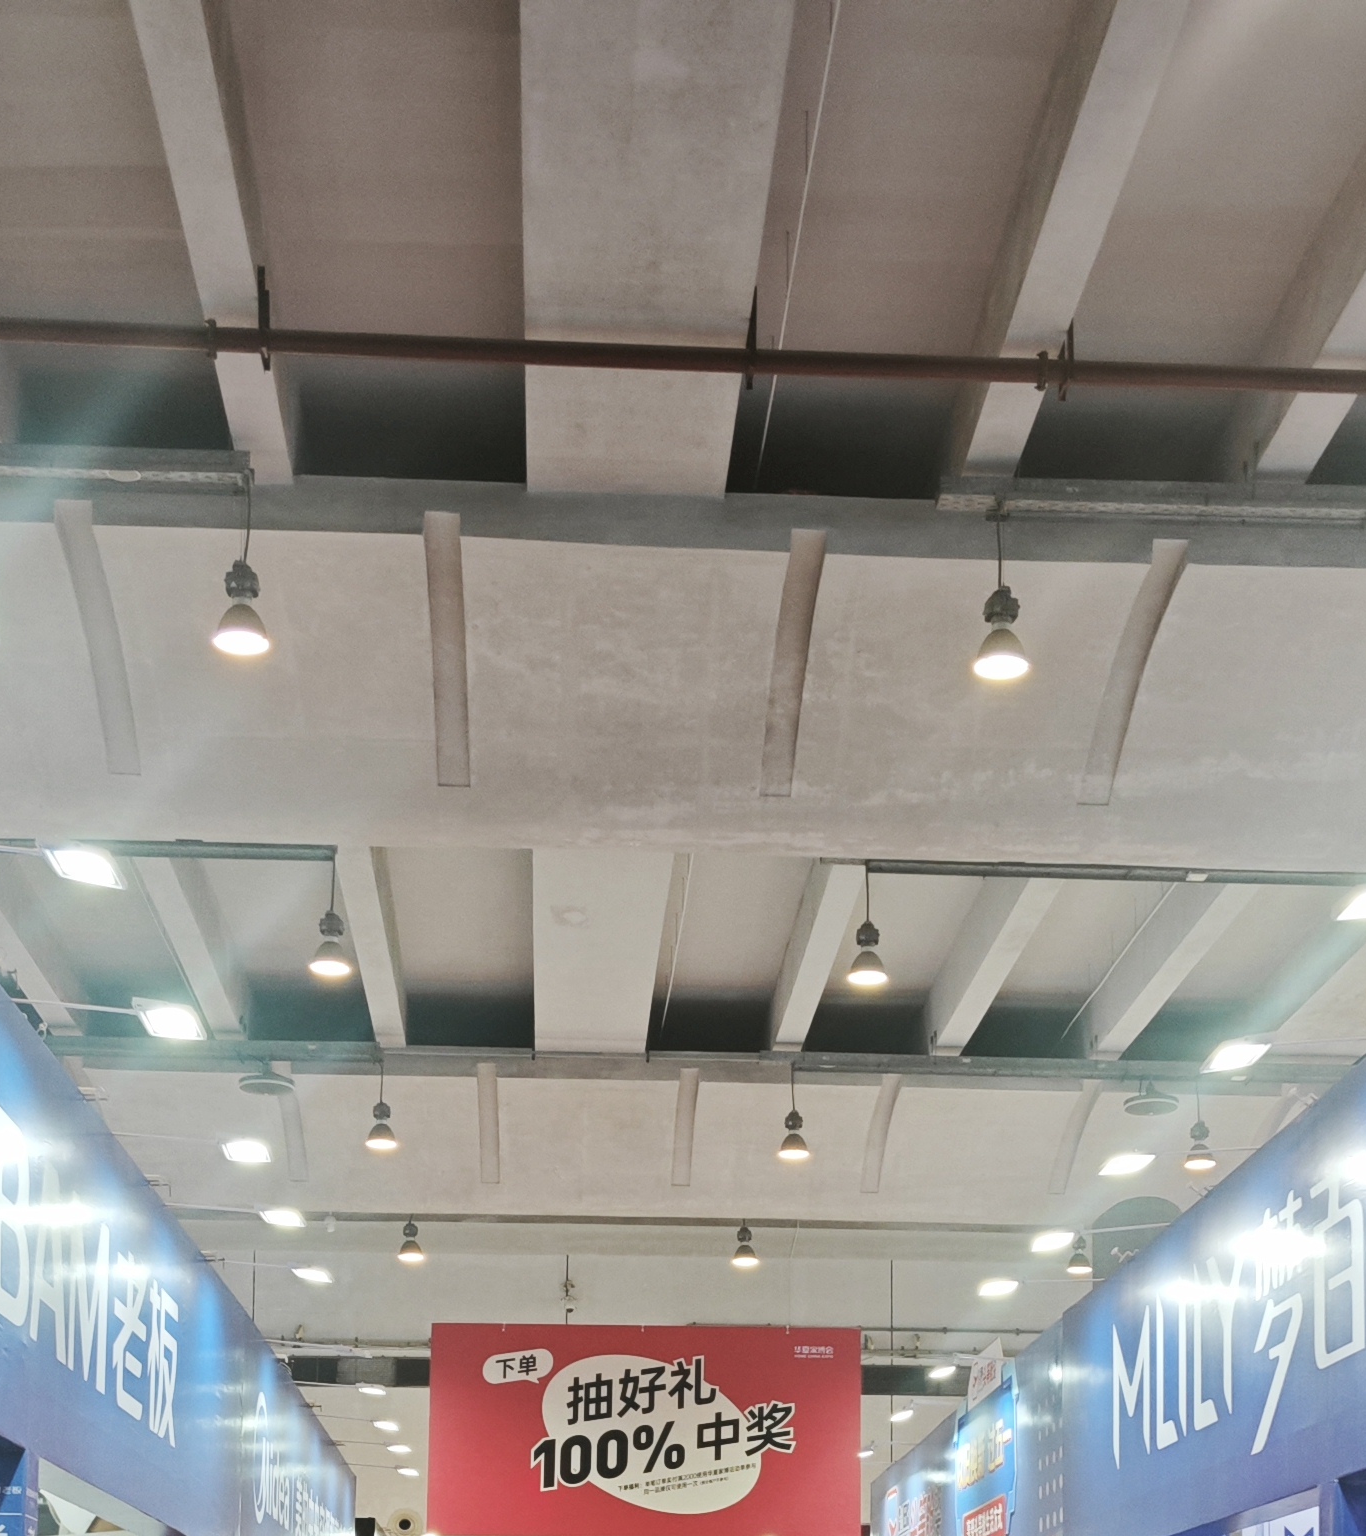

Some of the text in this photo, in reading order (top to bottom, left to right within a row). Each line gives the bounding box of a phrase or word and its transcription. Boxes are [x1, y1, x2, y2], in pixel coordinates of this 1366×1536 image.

[495, 1353, 538, 1380] 下单
[566, 1357, 718, 1426] 抽好礼
